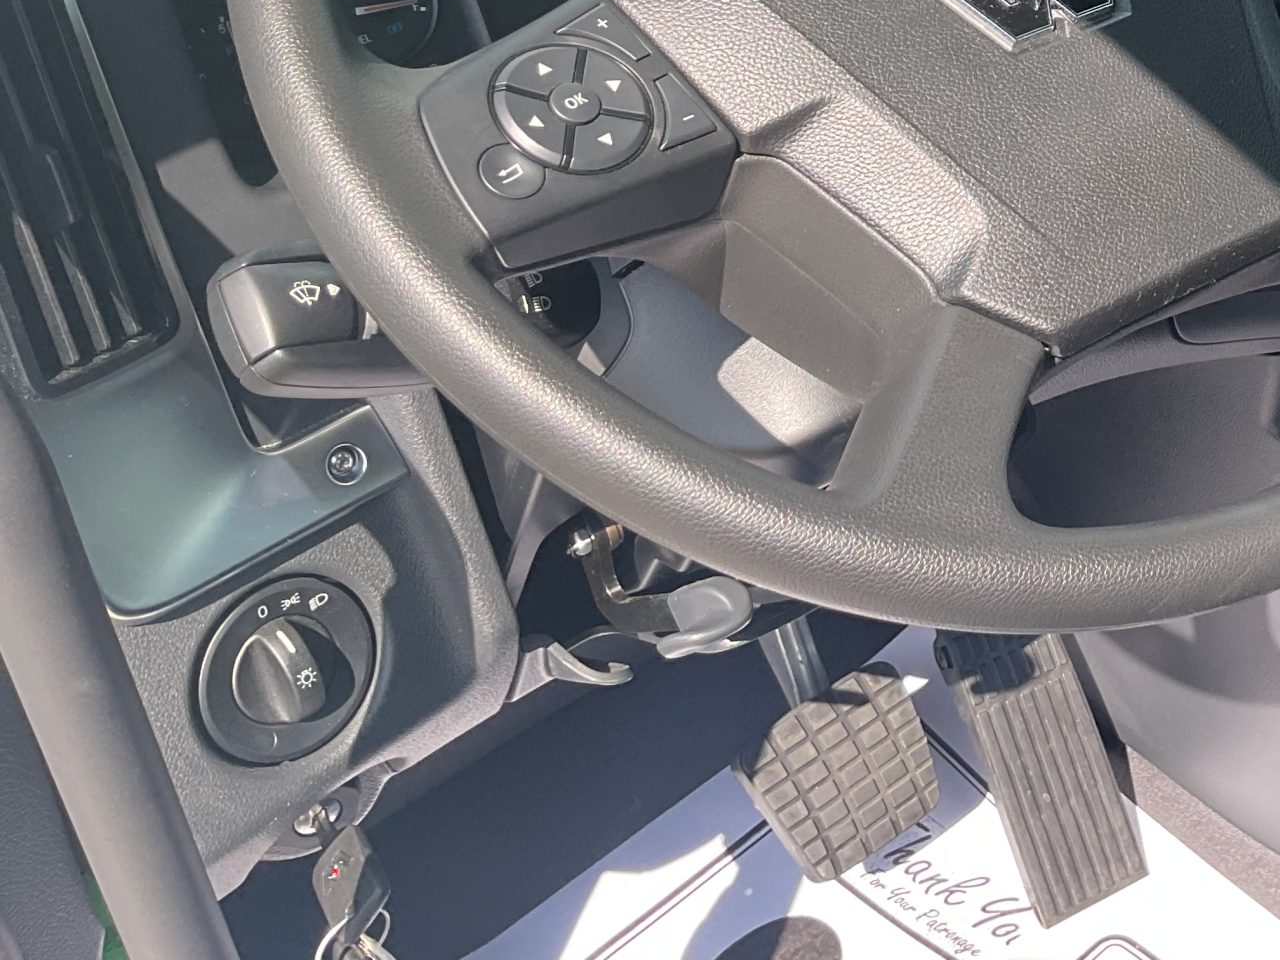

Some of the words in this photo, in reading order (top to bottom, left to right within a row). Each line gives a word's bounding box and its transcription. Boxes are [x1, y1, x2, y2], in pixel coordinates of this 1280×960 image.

[564, 92, 589, 110] OK
[884, 823, 991, 906] hank
[860, 868, 886, 889] For
[887, 887, 917, 912] Your
[916, 909, 981, 957] Patronage
